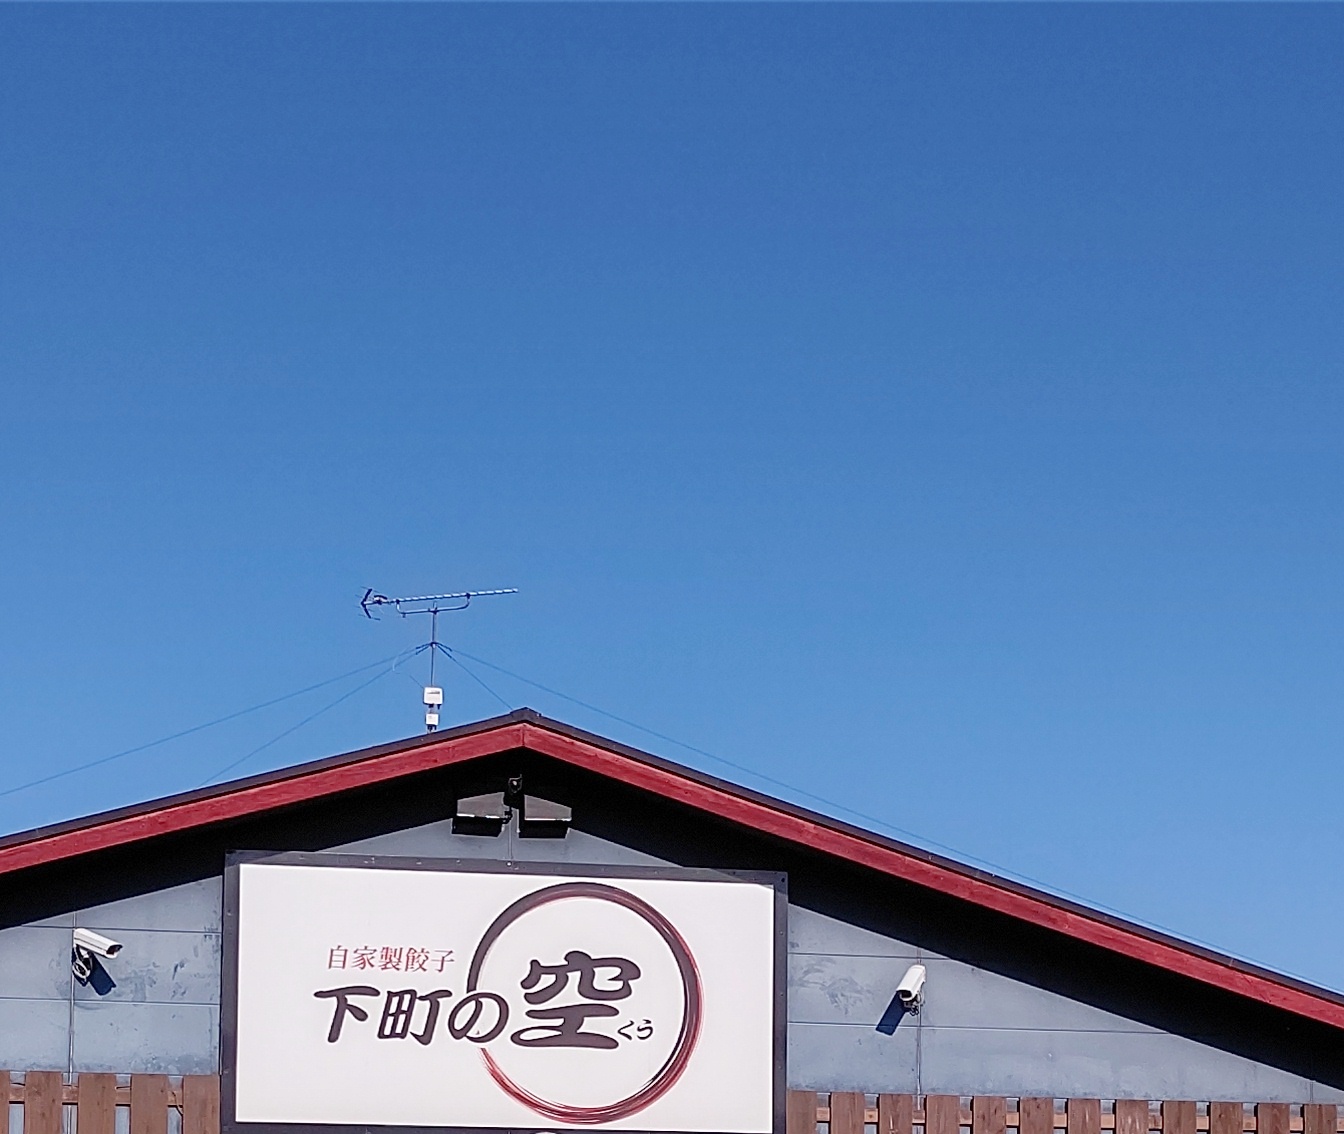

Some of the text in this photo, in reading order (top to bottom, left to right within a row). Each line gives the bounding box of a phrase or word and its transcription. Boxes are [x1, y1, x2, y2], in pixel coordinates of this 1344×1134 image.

[327, 945, 455, 974] 自家製餃子
[314, 951, 654, 1049] 下町の空 くう
